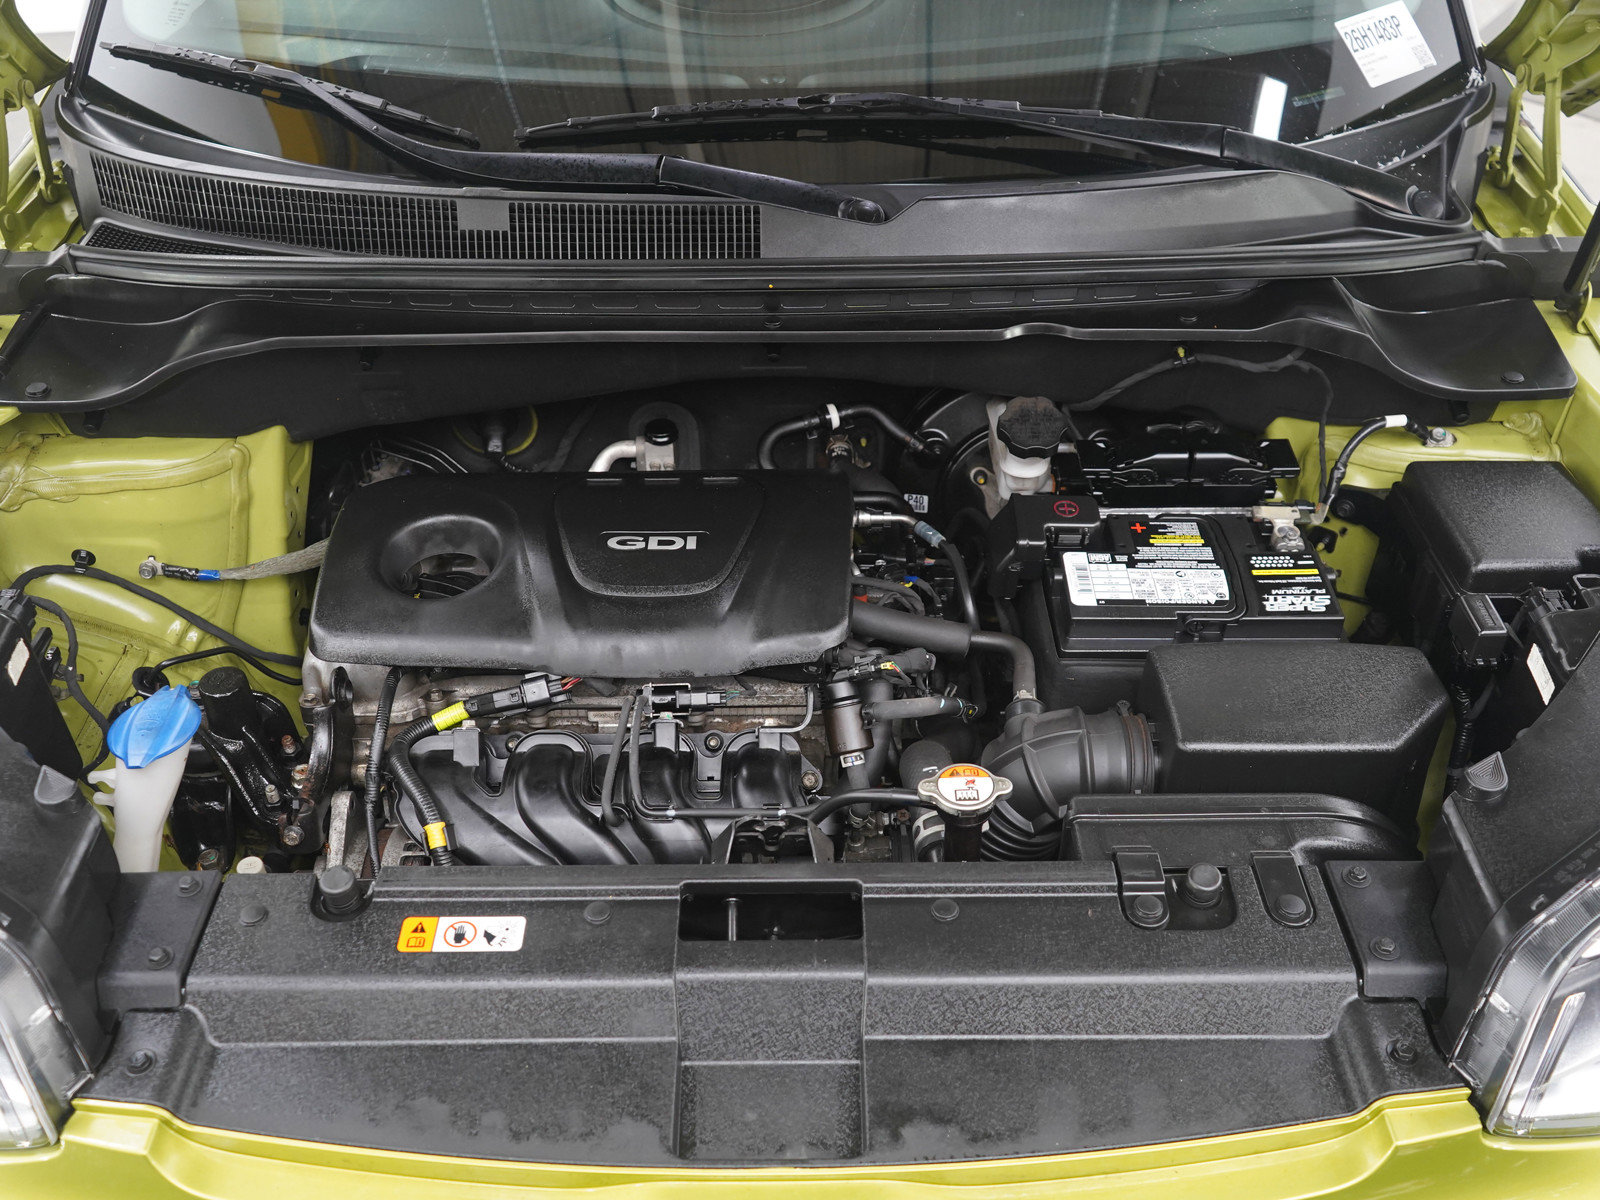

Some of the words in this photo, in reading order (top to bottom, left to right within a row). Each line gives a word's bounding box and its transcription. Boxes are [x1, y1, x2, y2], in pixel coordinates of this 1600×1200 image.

[1344, 15, 1402, 53] 26H1483P
[606, 536, 697, 550] GDI
[1263, 595, 1331, 605] START
[1265, 602, 1327, 612] SUPER
